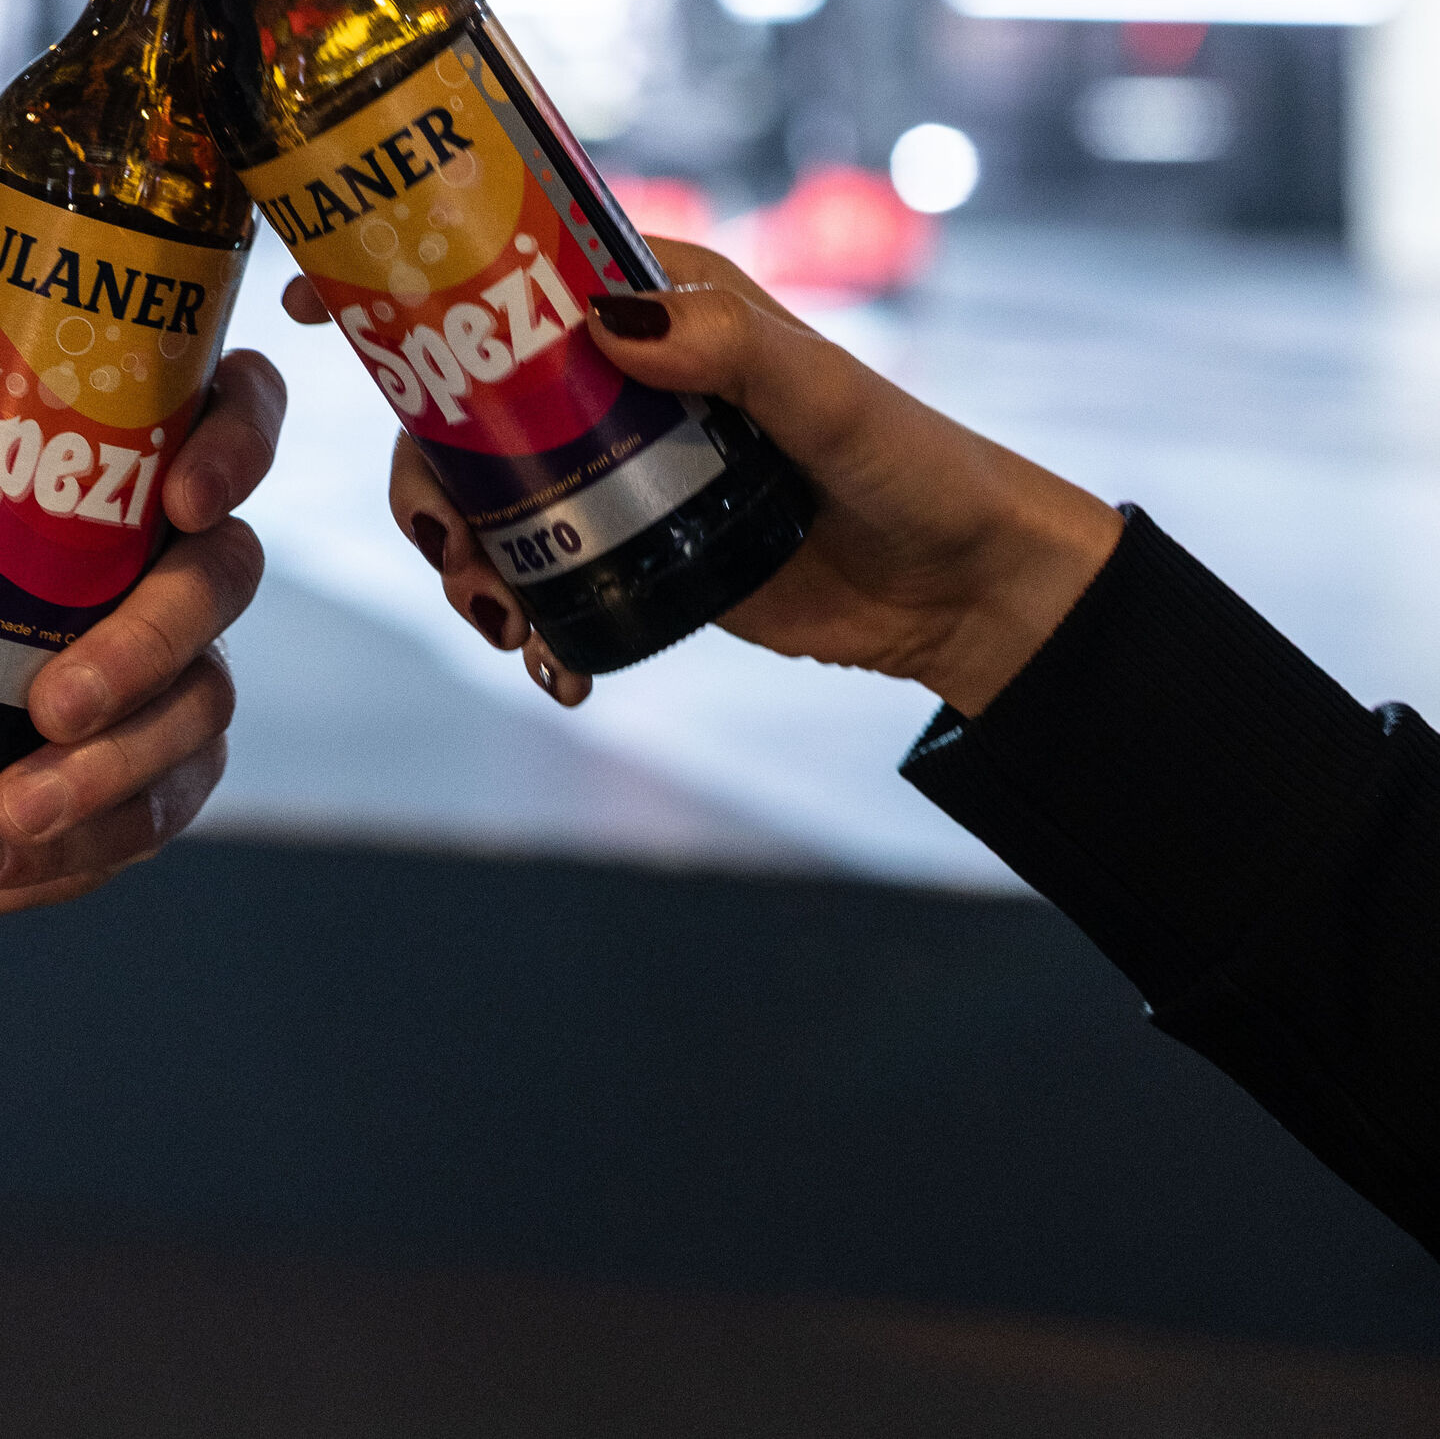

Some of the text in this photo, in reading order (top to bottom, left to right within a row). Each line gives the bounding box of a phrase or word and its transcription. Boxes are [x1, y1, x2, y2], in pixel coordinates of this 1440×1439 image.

[339, 231, 588, 427] Spezi
[499, 517, 583, 575] zero
[39, 631, 62, 644] mit
